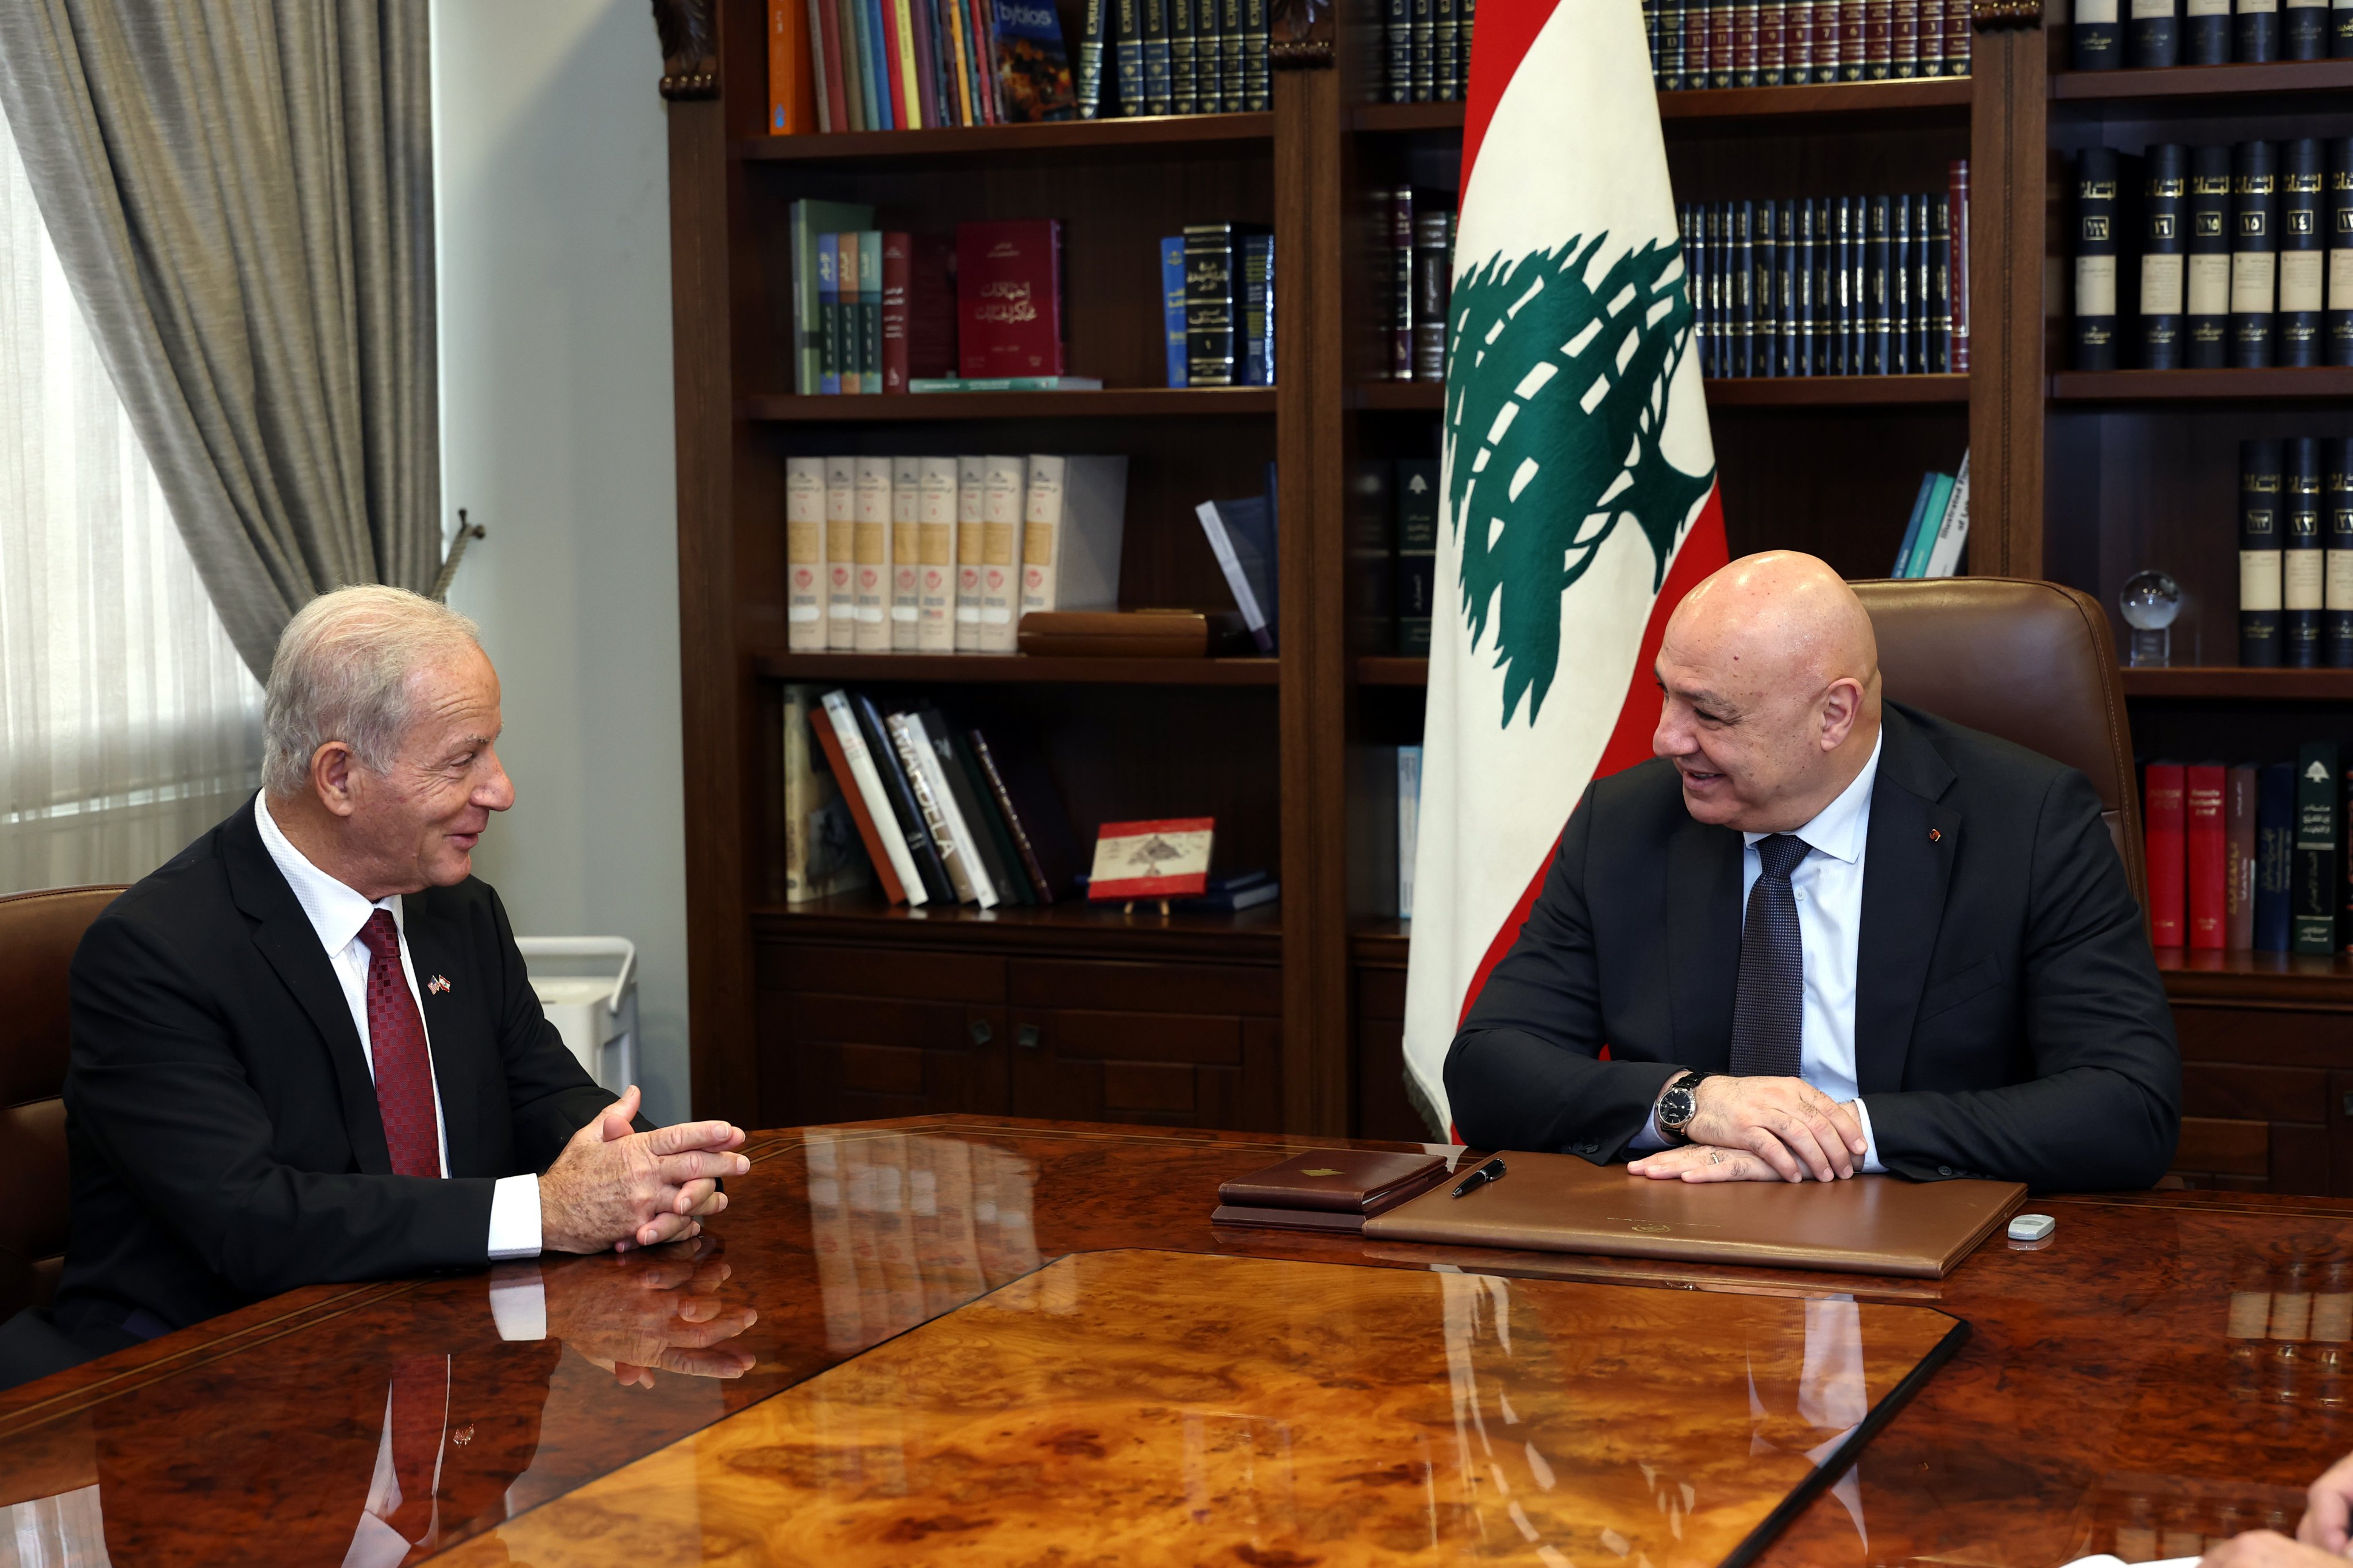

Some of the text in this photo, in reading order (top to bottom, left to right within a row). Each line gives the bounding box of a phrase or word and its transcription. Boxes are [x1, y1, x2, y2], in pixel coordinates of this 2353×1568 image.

[999, 1, 1052, 26] byblos
[1849, 26, 1858, 36] 6
[1877, 25, 1884, 36] 5
[1901, 23, 1909, 33] 4
[1929, 22, 1937, 33] 3
[1955, 20, 1963, 31] 2
[1717, 33, 1727, 44] 11
[1741, 33, 1753, 43] 10
[1768, 32, 1778, 41] 9
[1823, 28, 1830, 38] 7
[2244, 216, 2260, 231] ١٥
[2292, 214, 2308, 230] ١٤
[892, 725, 956, 861] MANDELA
